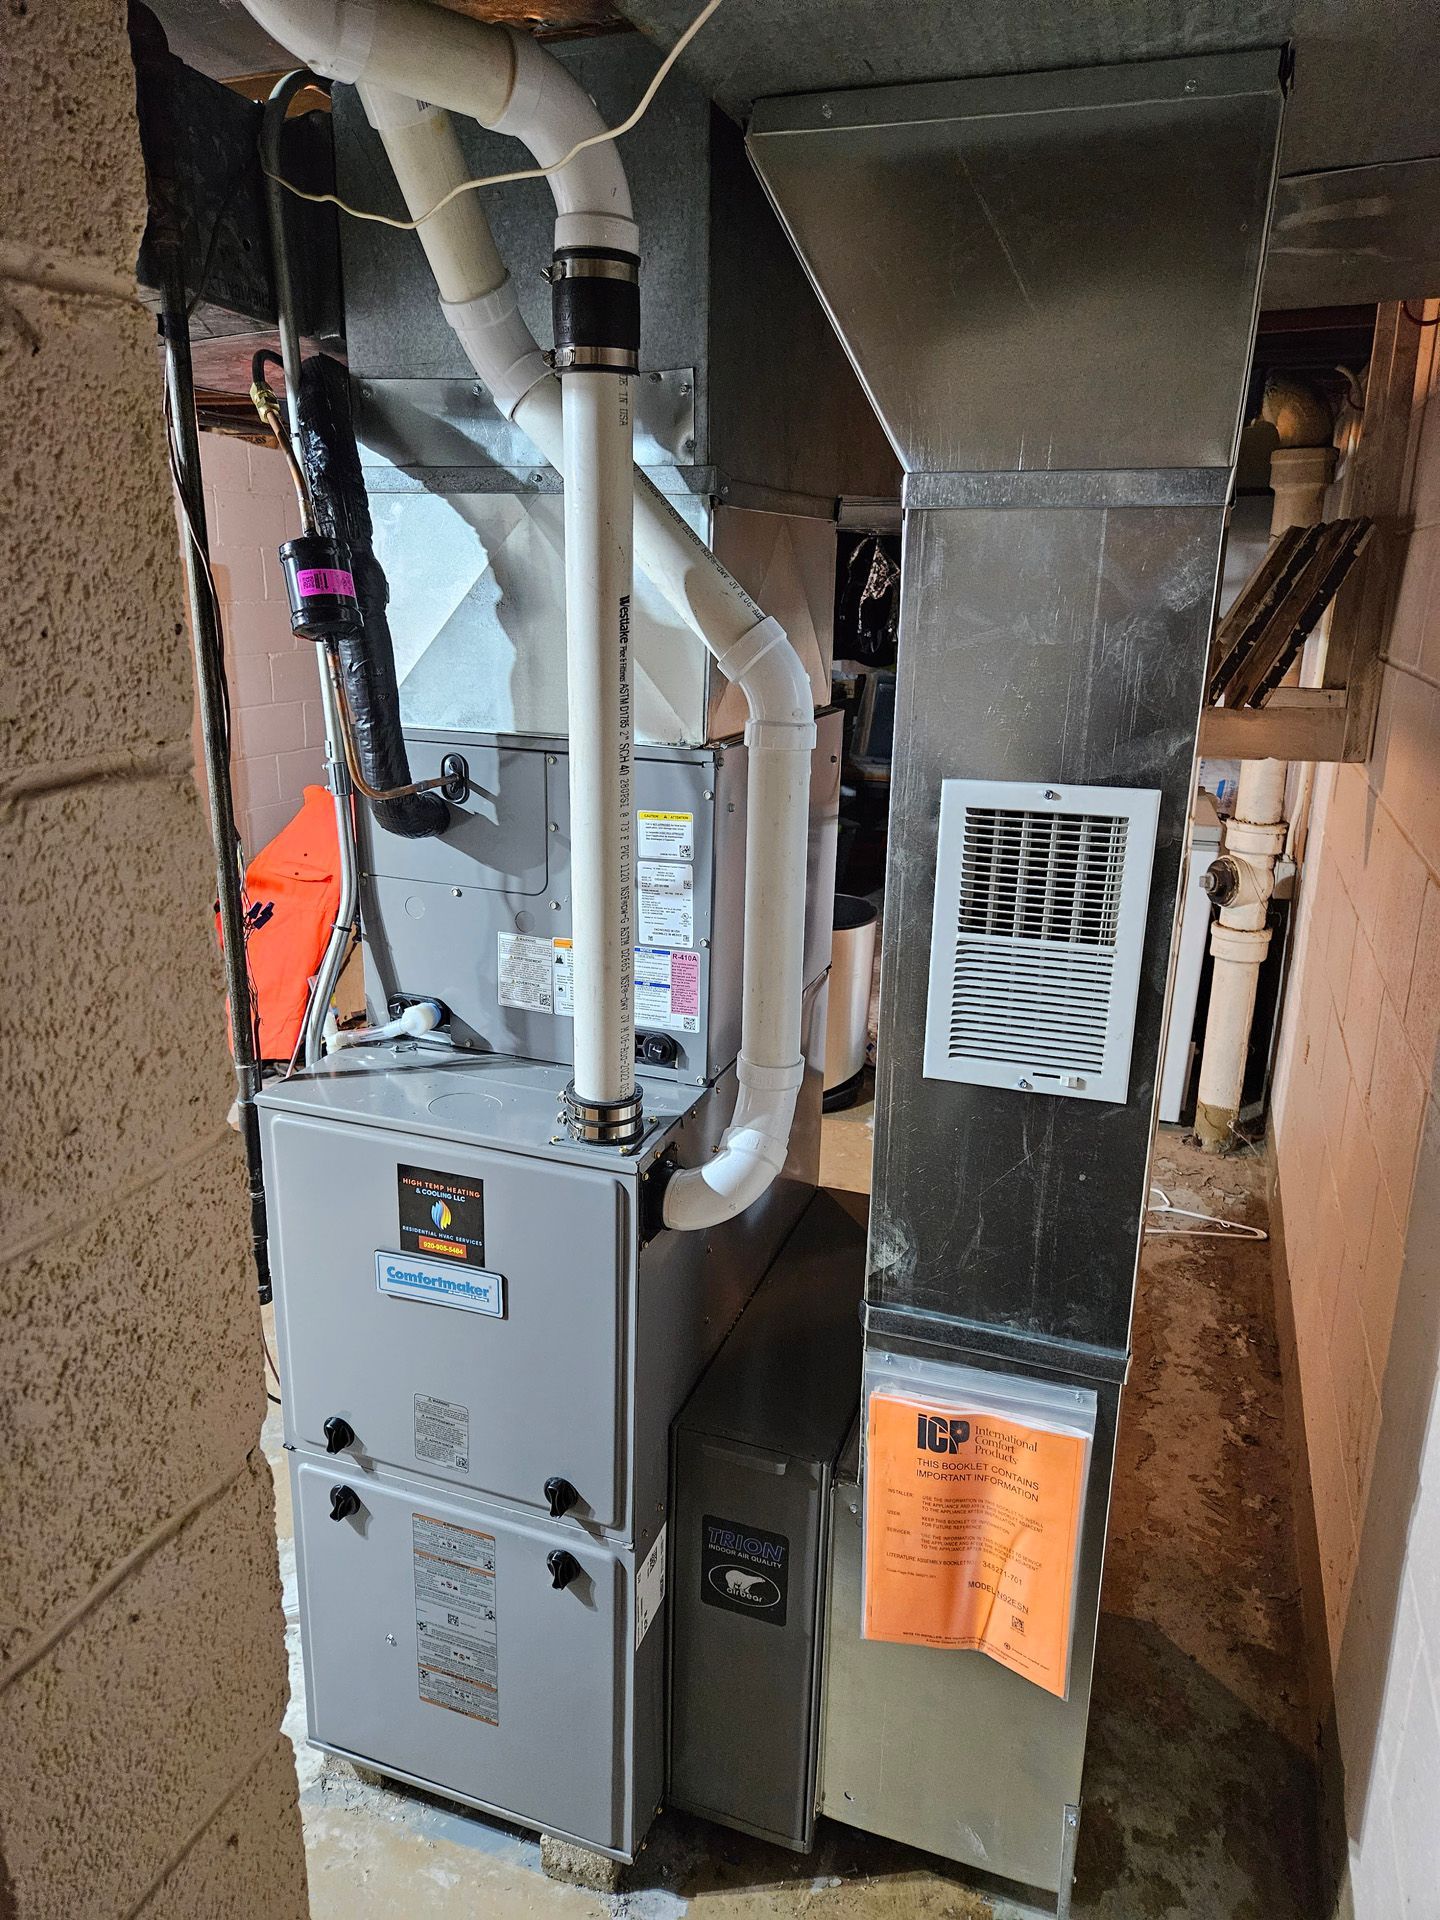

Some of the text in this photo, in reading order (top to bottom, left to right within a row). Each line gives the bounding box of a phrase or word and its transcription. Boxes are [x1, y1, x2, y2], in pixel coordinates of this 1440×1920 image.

[619, 408, 629, 426] USA
[619, 594, 631, 644] Westlake
[620, 683, 629, 705] ASTM
[620, 705, 629, 729] D1785
[619, 743, 630, 763] SCH
[619, 764, 630, 776] 40
[620, 844, 630, 860] PVC
[620, 862, 630, 883] 1120
[620, 926, 630, 946] ASTM
[621, 948, 630, 972] D2665
[672, 953, 698, 962] R-410A
[402, 1177, 481, 1199] HIGH TEMP HEATING
[421, 1188, 453, 1200] COOLING
[453, 1194, 466, 1203] LLC
[402, 1225, 483, 1247] RESIDENTIAL HVAC SERVICES
[386, 1265, 490, 1298] Comfortmaker
[974, 1425, 1038, 1452] International
[974, 1435, 1015, 1455] Comfort
[974, 1445, 1018, 1465] Products
[917, 1458, 1040, 1491] THIS BOOKLET CONTAINS
[916, 1469, 1039, 1502] IMPORTANT INFORMATION
[708, 1526, 783, 1562] TRION
[708, 1543, 782, 1569] INDOOR AIR QUALITY
[886, 1551, 916, 1562] LITERATURE
[916, 1557, 942, 1565] ASSEMBLY
[726, 1586, 763, 1603] airbear
